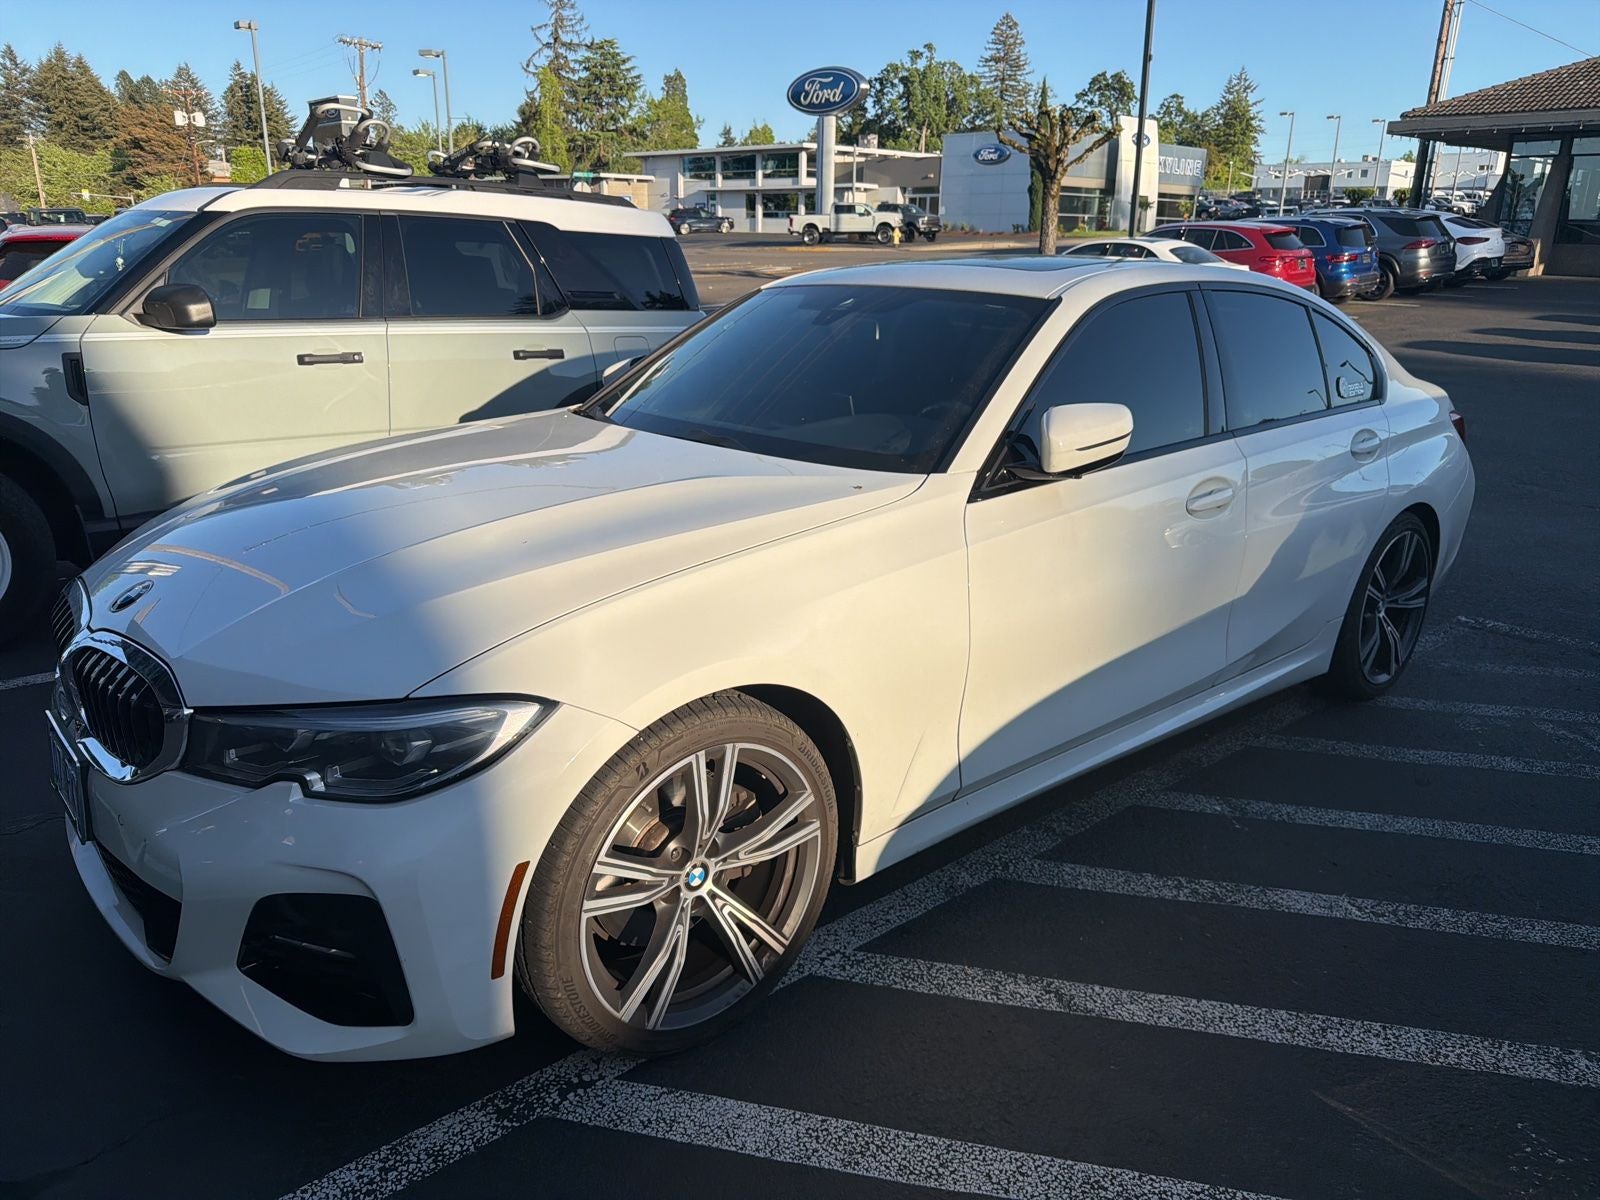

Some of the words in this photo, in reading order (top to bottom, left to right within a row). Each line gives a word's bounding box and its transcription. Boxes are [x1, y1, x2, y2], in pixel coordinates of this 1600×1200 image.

[801, 76, 844, 105] Ford
[978, 148, 1000, 161] Ford
[1158, 155, 1203, 177] KYLINE
